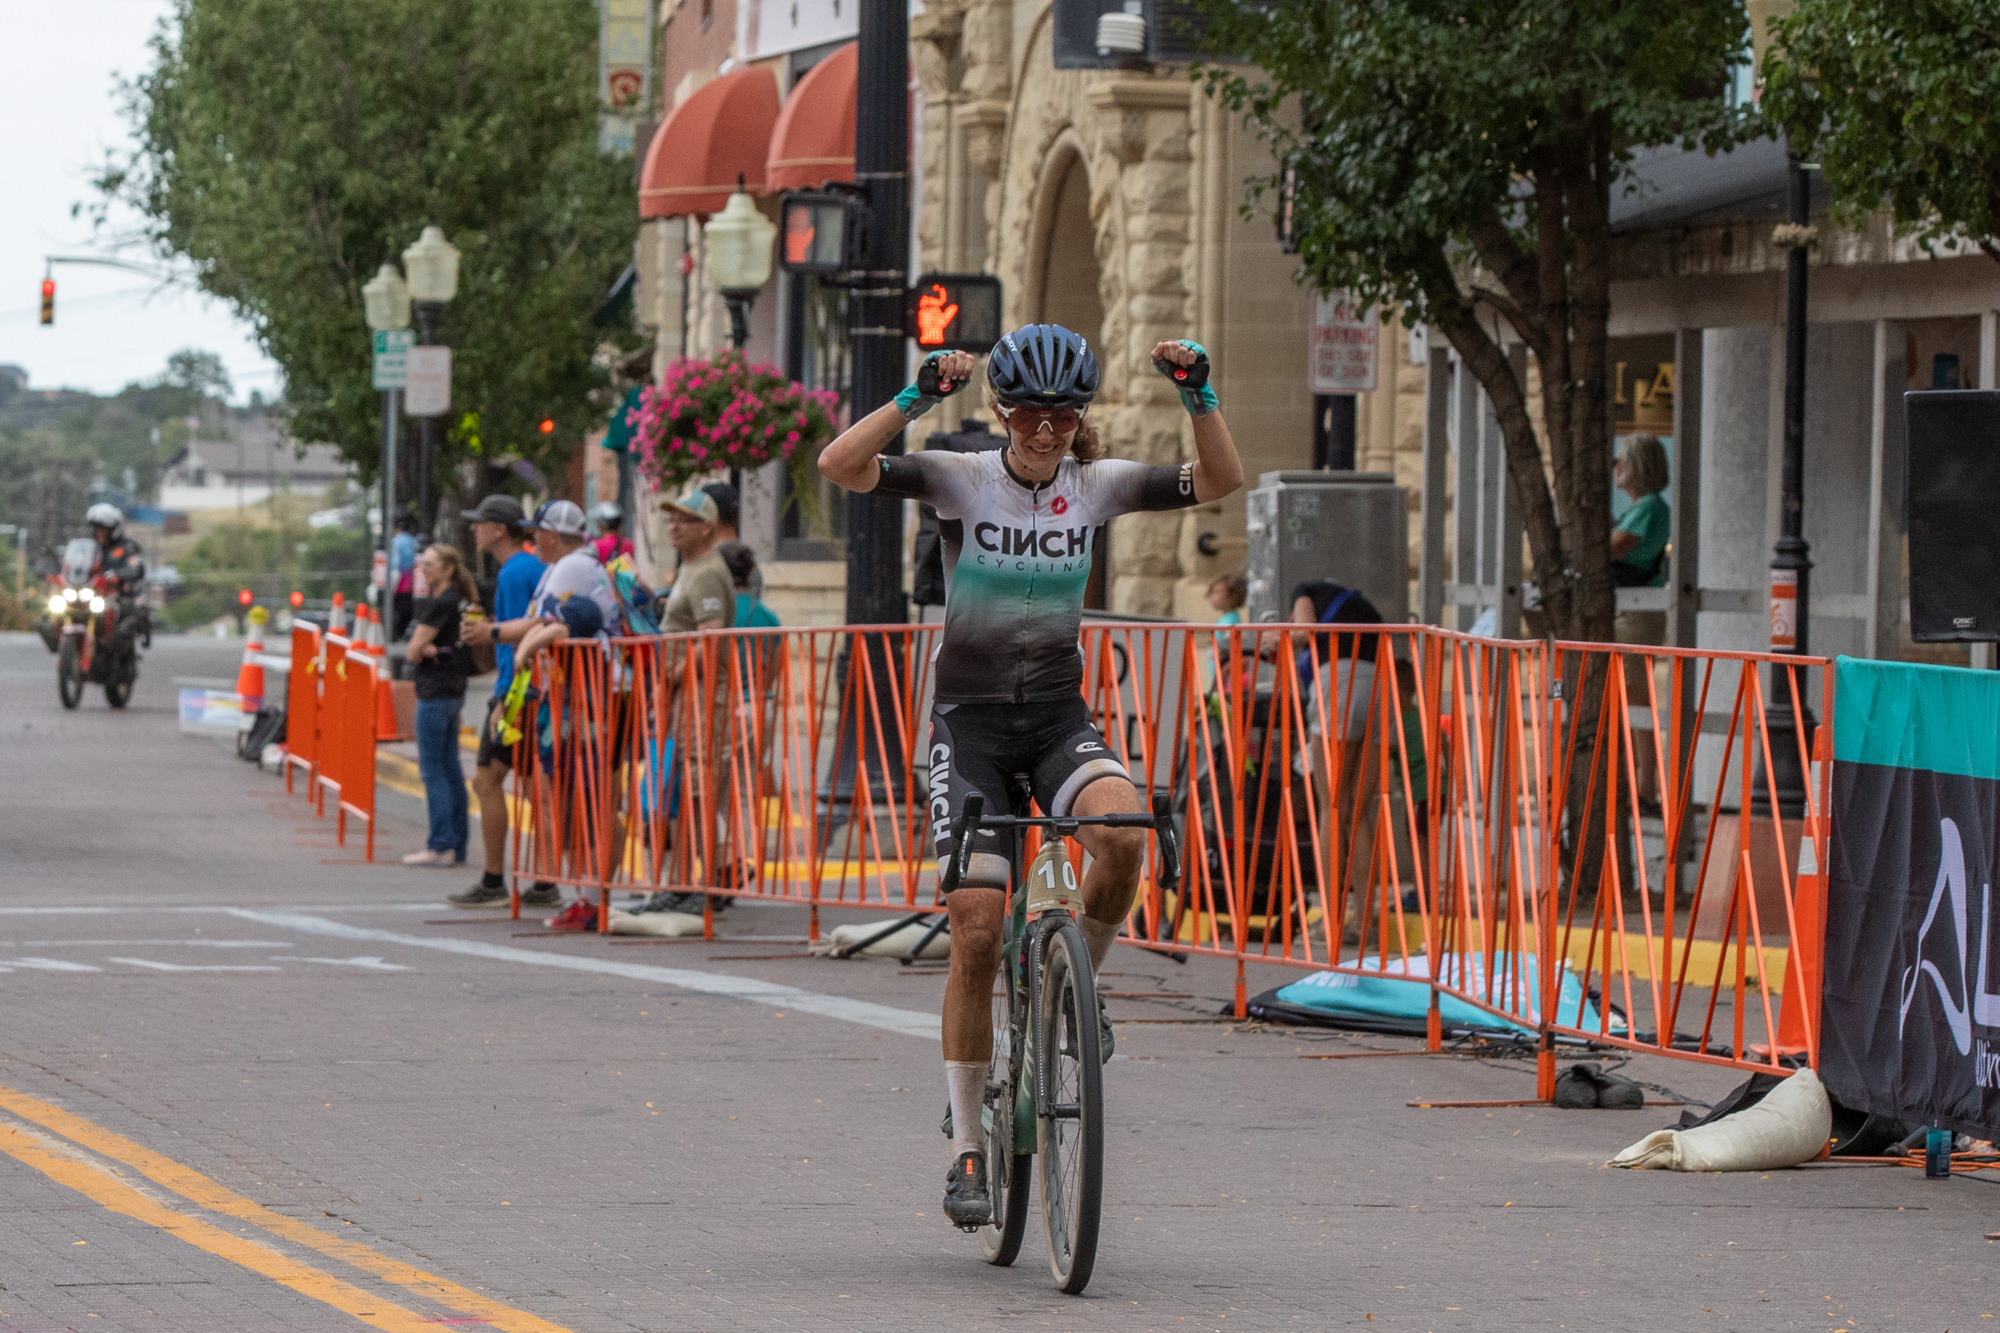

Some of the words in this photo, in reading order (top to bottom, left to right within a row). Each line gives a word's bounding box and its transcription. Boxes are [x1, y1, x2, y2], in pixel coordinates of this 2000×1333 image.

[1313, 326, 1376, 345] PARKING
[974, 521, 1088, 558] CINCH
[977, 555, 1084, 572] CYCLING
[929, 742, 952, 844] CINCH
